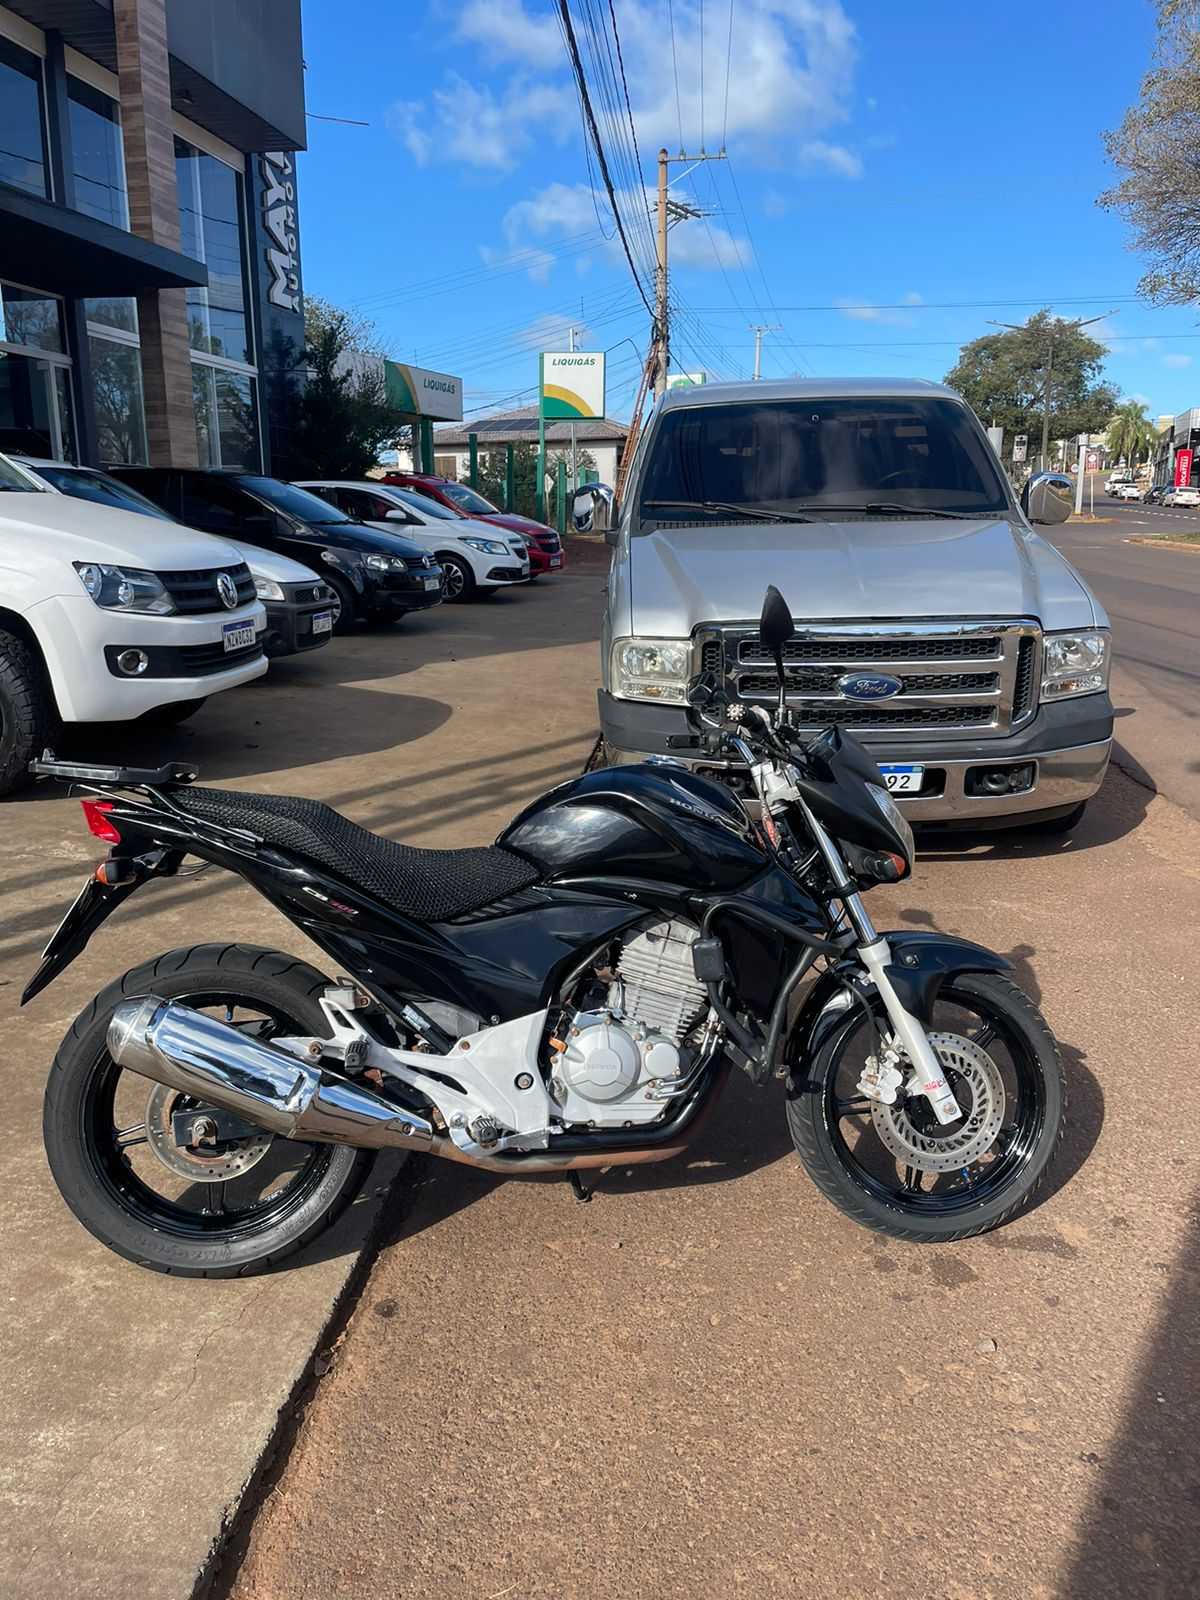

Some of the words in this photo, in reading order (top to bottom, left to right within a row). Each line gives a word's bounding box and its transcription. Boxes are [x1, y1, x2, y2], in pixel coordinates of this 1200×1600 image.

[552, 356, 597, 366] LIQUIGÁS
[423, 377, 456, 395] LIQUIGÁS
[854, 679, 888, 694] Ford
